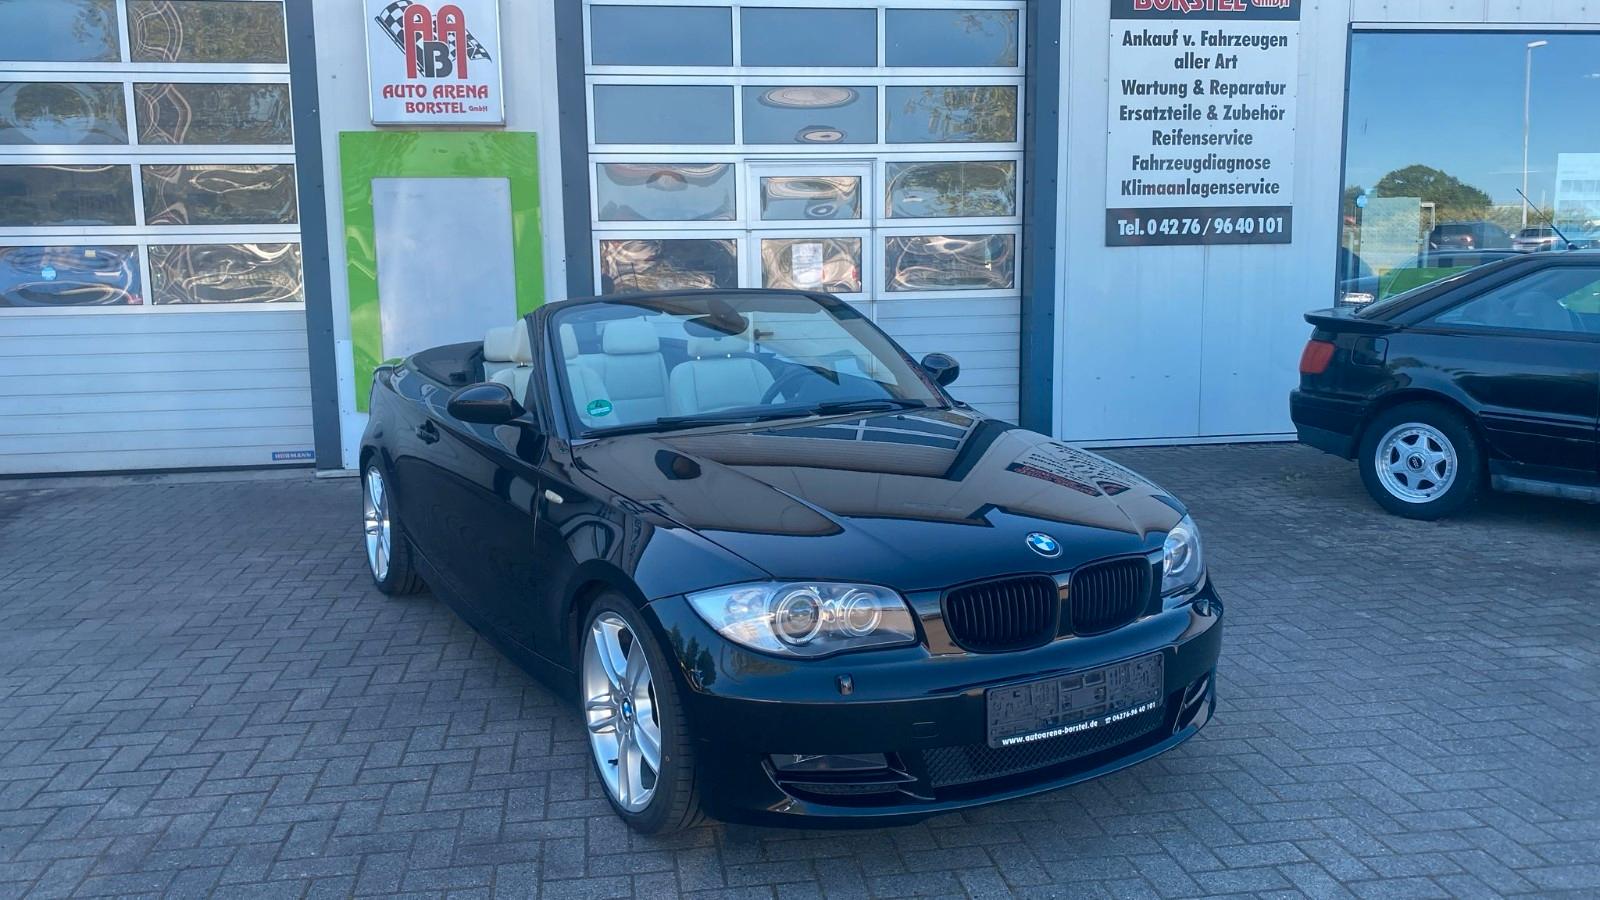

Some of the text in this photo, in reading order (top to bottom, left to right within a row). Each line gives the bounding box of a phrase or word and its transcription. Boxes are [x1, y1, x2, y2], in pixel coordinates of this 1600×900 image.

[1122, 29, 1288, 50] Ankauf v. Fahrzeugen
[1174, 52, 1238, 69] aller Art
[382, 85, 489, 99] AUTO ARENA
[1121, 79, 1287, 98] Wartung & Reparatur
[405, 101, 467, 114] BORSTEL
[1119, 104, 1286, 121] Ersatzteile & Zubehör
[1152, 128, 1253, 146] Reifenservice
[1132, 153, 1271, 174] Fahrzeugdiagnose
[1121, 178, 1280, 198] Klimaanlagenservice
[1117, 218, 1145, 236] Tel.
[1258, 217, 1283, 234] 101
[1002, 720, 1098, 745] www.autoarena-borstel.de
